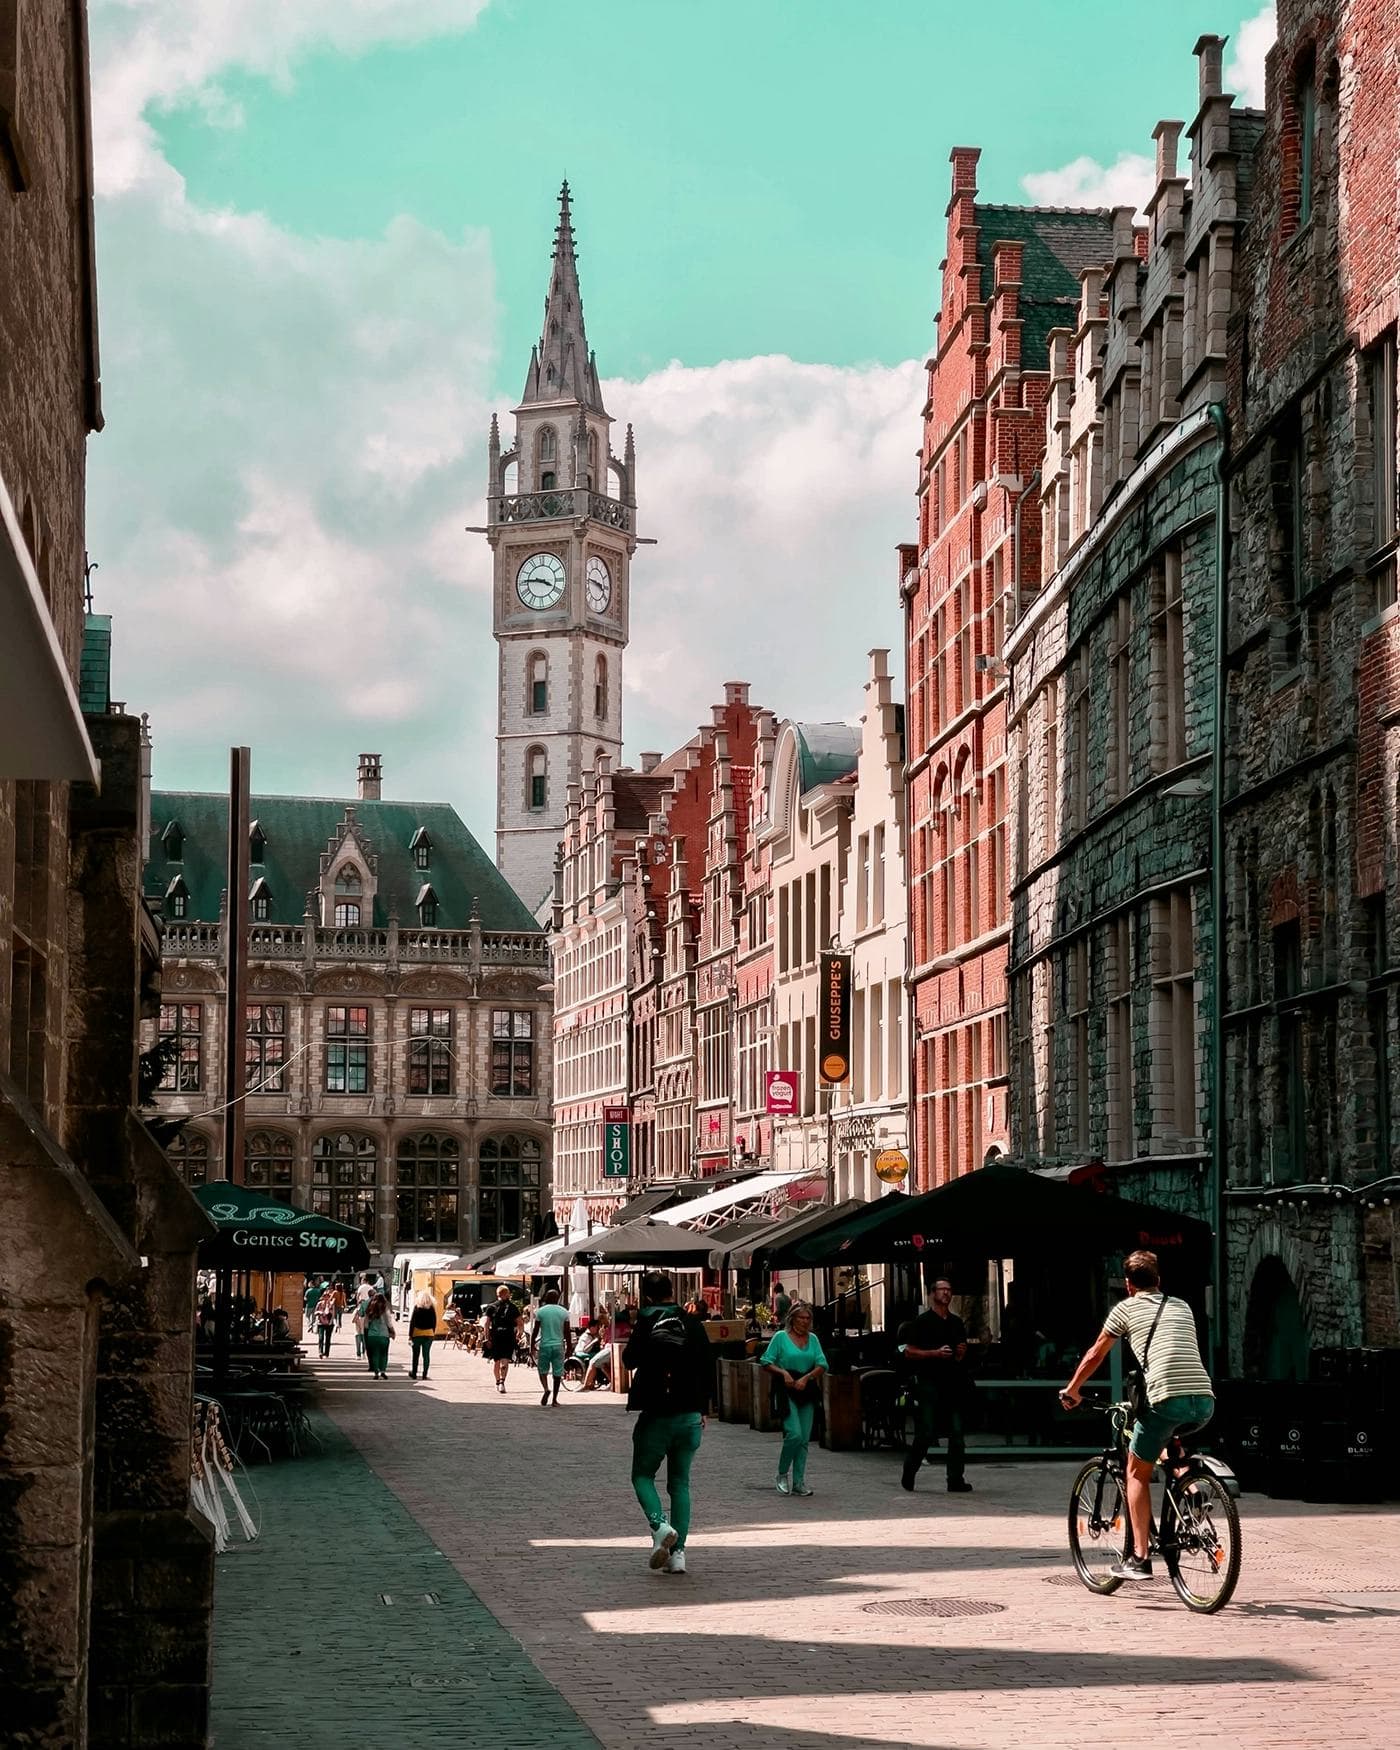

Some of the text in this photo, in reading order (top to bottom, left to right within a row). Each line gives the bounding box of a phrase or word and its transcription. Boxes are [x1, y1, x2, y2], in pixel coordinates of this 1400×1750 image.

[830, 960, 842, 1040] GIUSEPPE'S
[611, 1124, 623, 1174] SHOP
[232, 1229, 348, 1253] Gentse Strop
